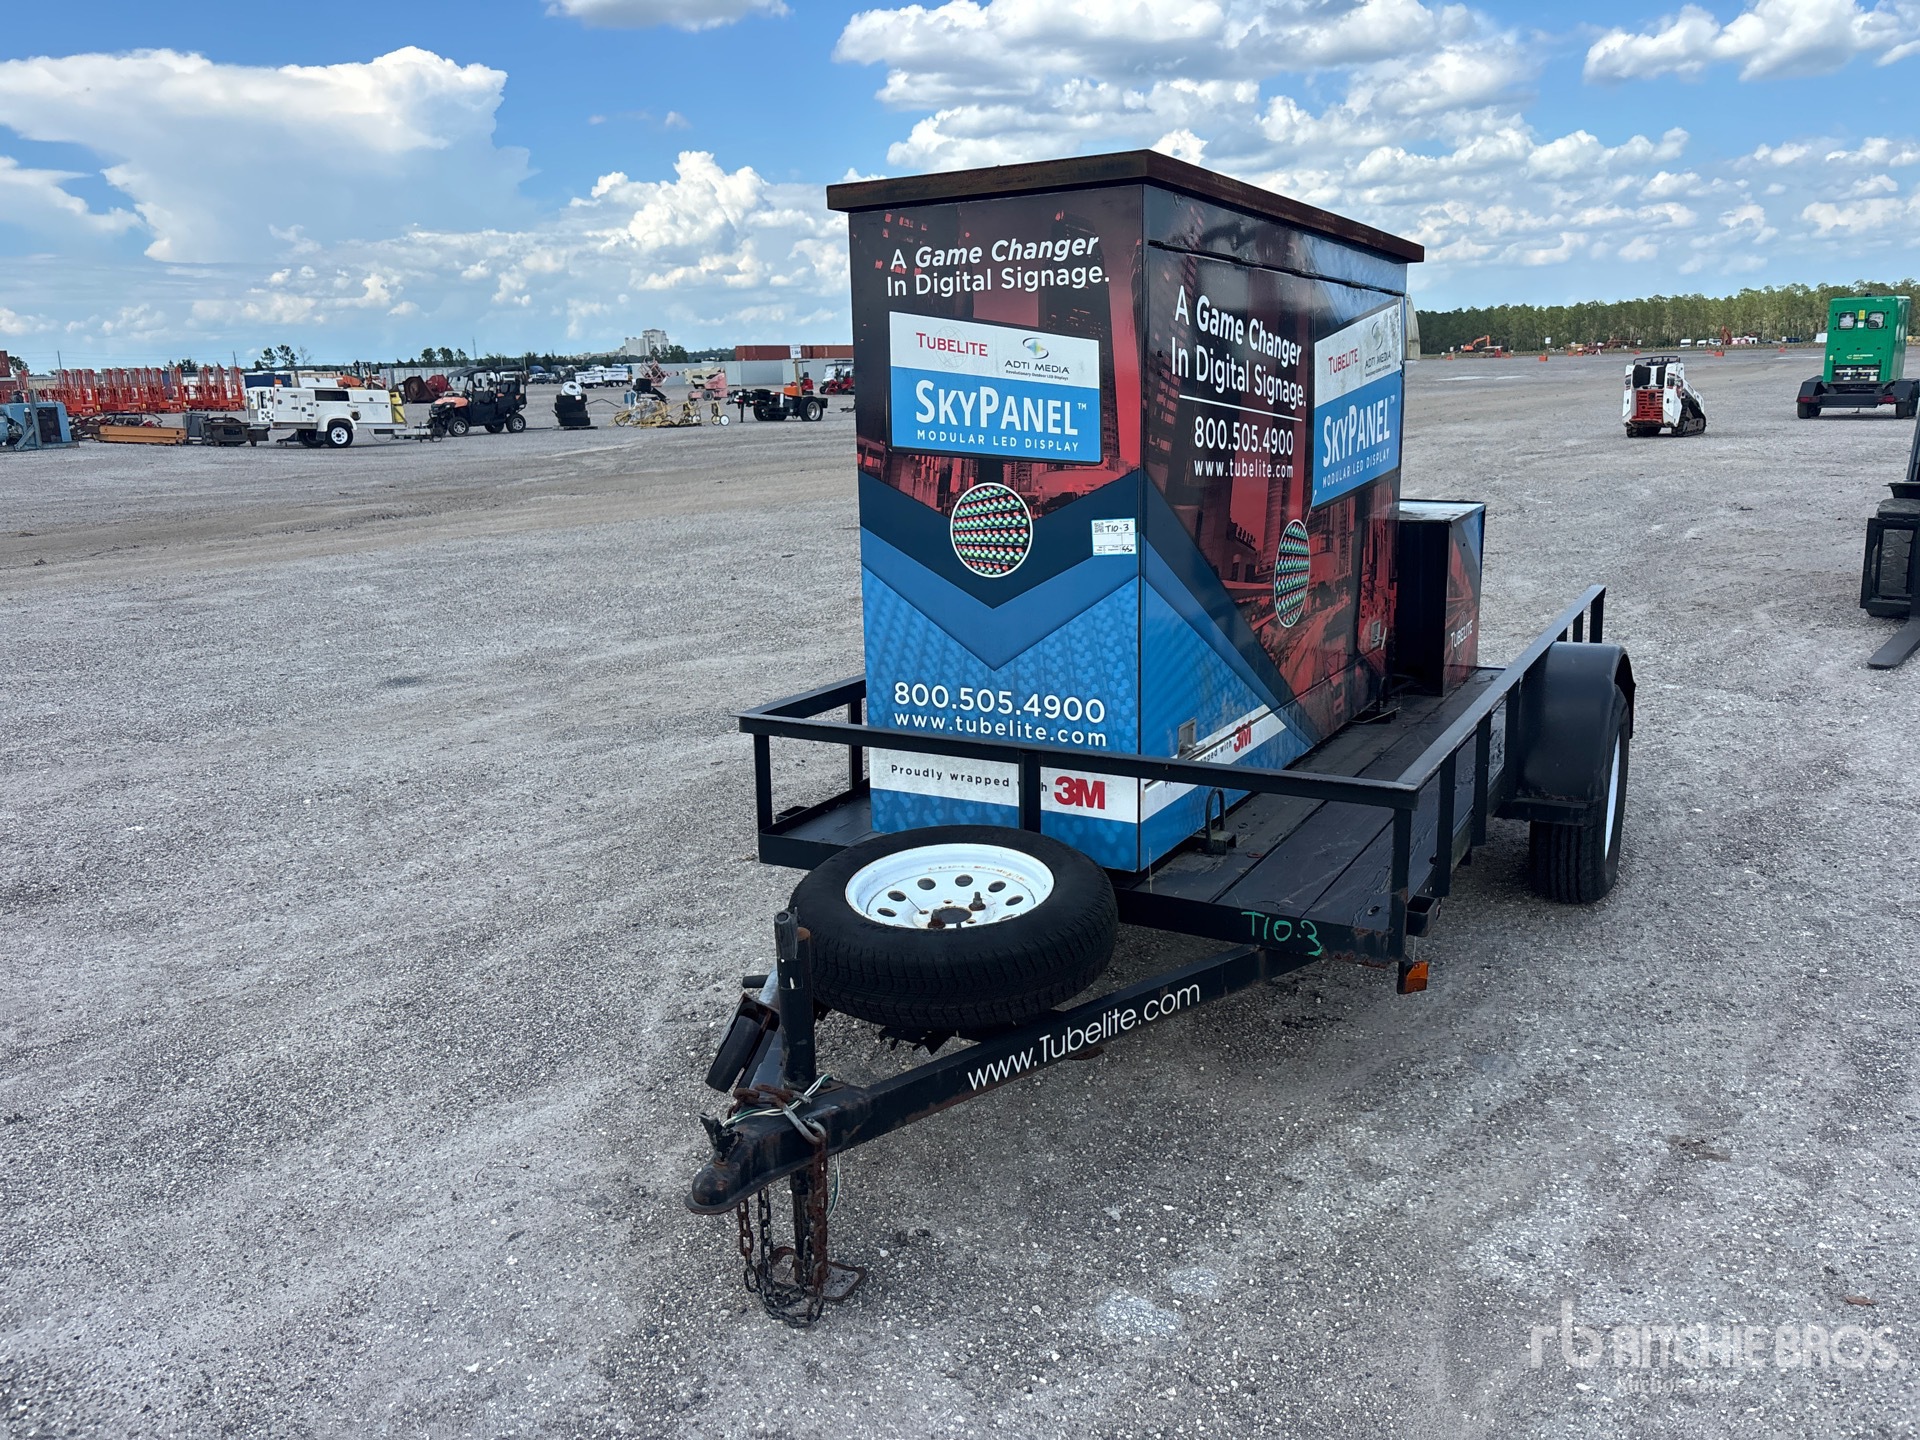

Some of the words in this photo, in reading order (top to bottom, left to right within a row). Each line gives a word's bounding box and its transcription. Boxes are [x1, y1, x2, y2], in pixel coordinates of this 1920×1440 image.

[890, 249, 906, 270] A
[915, 245, 982, 268] Game
[991, 236, 1099, 262] Changer
[887, 277, 907, 297] In
[915, 269, 992, 298] Digital
[1001, 264, 1110, 292] Signage.
[1174, 285, 1190, 326] A
[1196, 295, 1244, 345] Game
[1249, 318, 1302, 368] Changer
[916, 332, 988, 357] TUBELITE
[1328, 348, 1358, 375] TUBELITE
[1005, 360, 1030, 370] ADTI
[1034, 363, 1070, 374] MEDIA
[1171, 337, 1189, 378] In
[1196, 345, 1250, 393] Digital
[1254, 364, 1307, 410] Signage.
[917, 429, 985, 445] MODULAR
[993, 435, 1017, 447] LED
[1025, 439, 1079, 452] DISPLAY
[1194, 416, 1294, 456] 800.505.4900
[1194, 458, 1294, 478] www.tubelite.com
[1323, 465, 1350, 488] MODULAR
[1353, 460, 1363, 475] LED
[1366, 448, 1389, 469] DISPLAY
[894, 682, 1105, 724] 800.505.4900
[894, 712, 1107, 747] www.tubelite.com
[1234, 720, 1252, 752] 3M
[891, 764, 943, 780] Proudly
[950, 774, 1010, 787] wrapped
[1054, 776, 1106, 810] 3M
[967, 983, 1201, 1091] www.Tubelite.com
